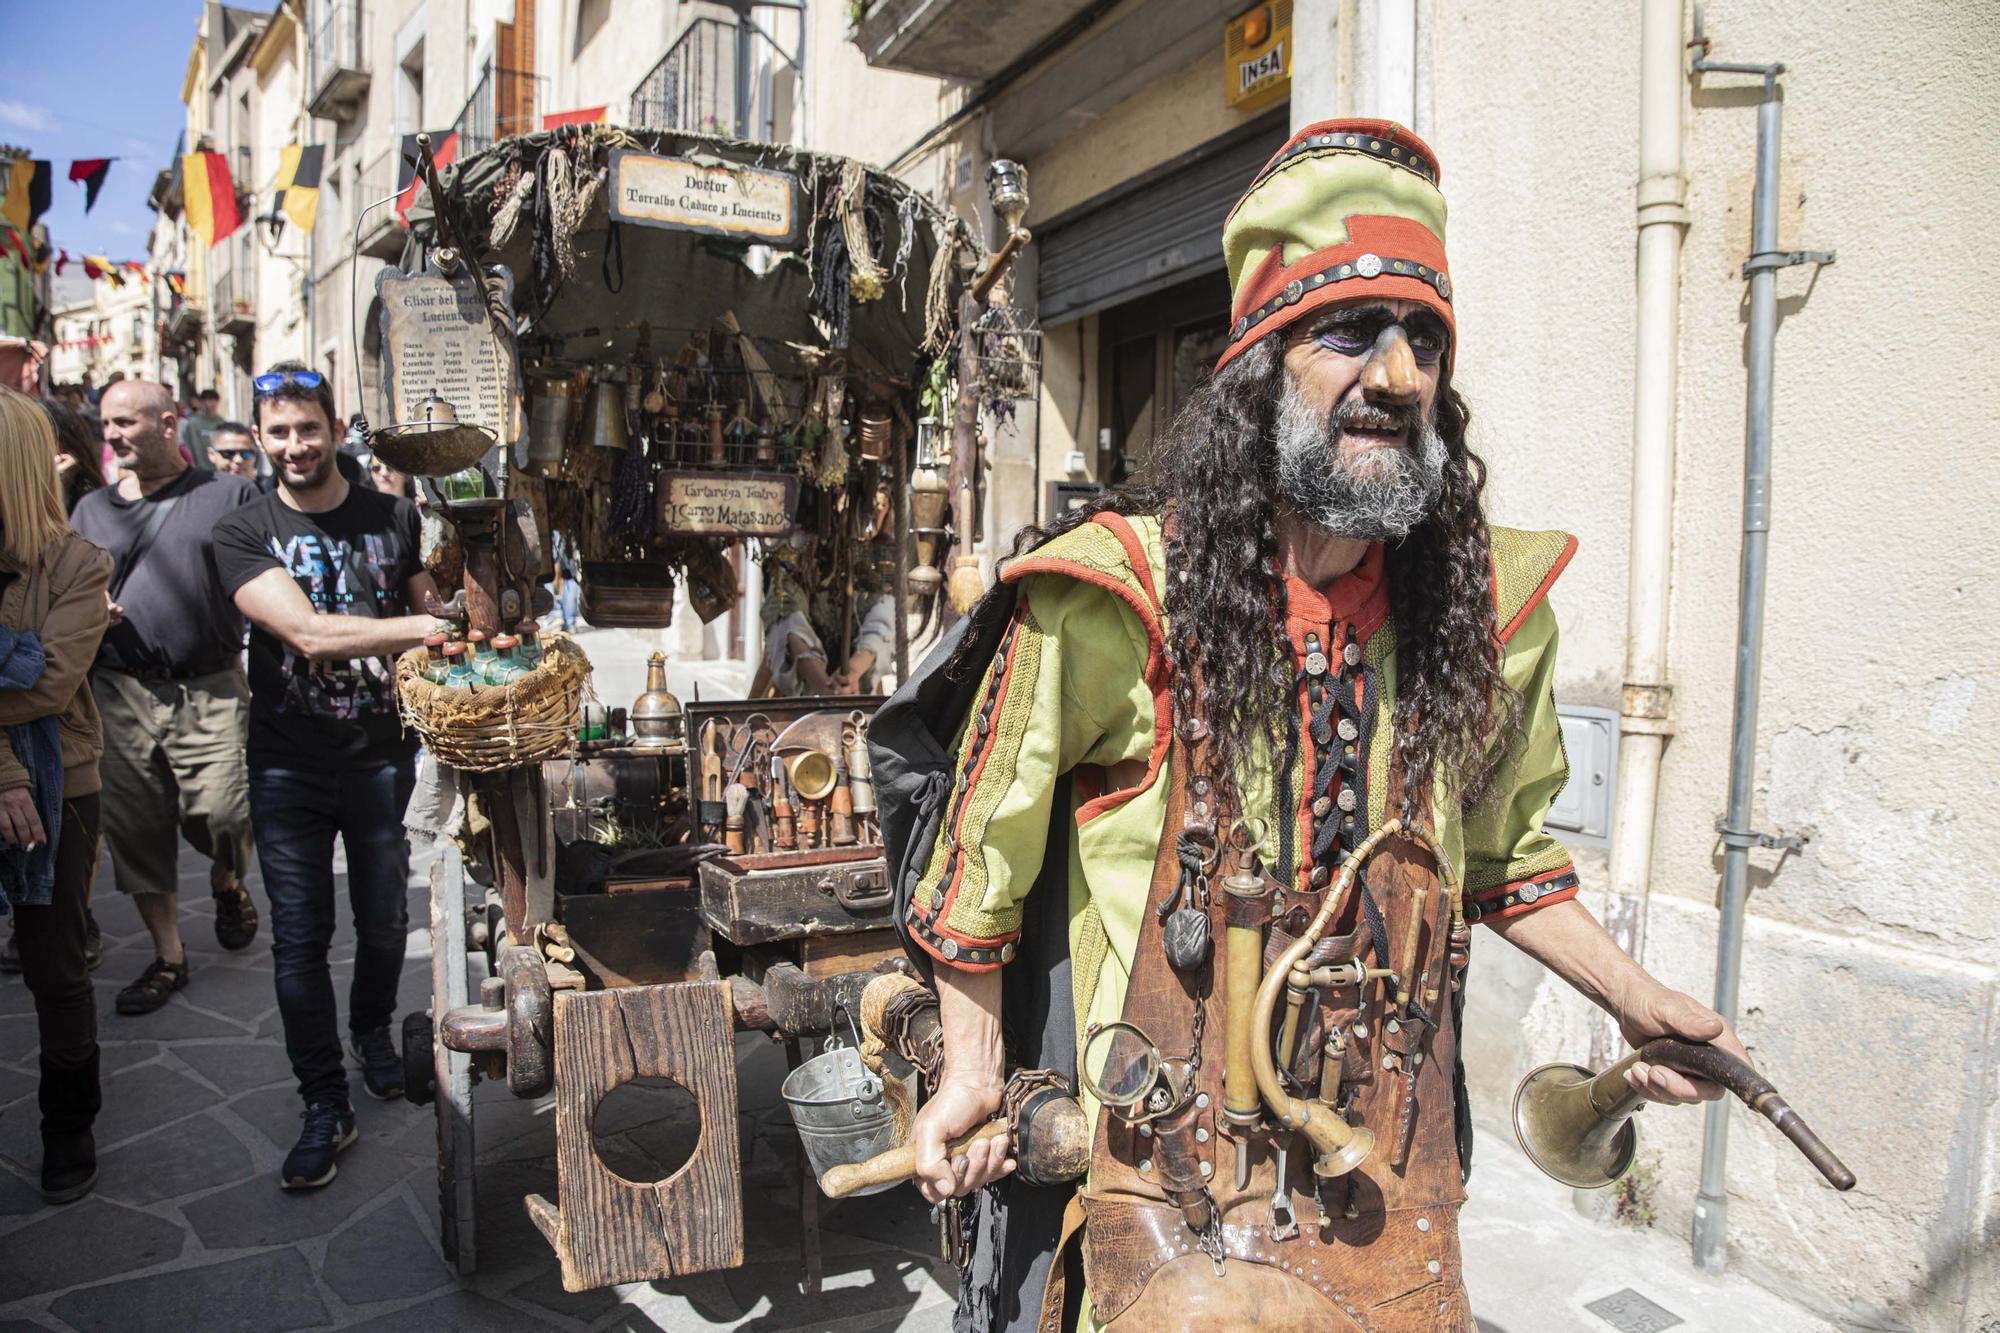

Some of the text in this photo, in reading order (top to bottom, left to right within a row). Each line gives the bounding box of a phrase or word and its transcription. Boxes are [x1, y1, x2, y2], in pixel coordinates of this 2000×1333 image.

[1242, 49, 1280, 88] INSA
[685, 175, 728, 193] Doctor
[626, 188, 676, 206] Torralbo
[679, 195, 718, 213] Caduco
[732, 203, 782, 222] Lucientes
[404, 295, 435, 307] Elixir
[438, 294, 454, 305] del
[682, 483, 778, 500] Tartaruga Teatro
[679, 504, 714, 526] Carro
[717, 505, 792, 529] Matasanos
